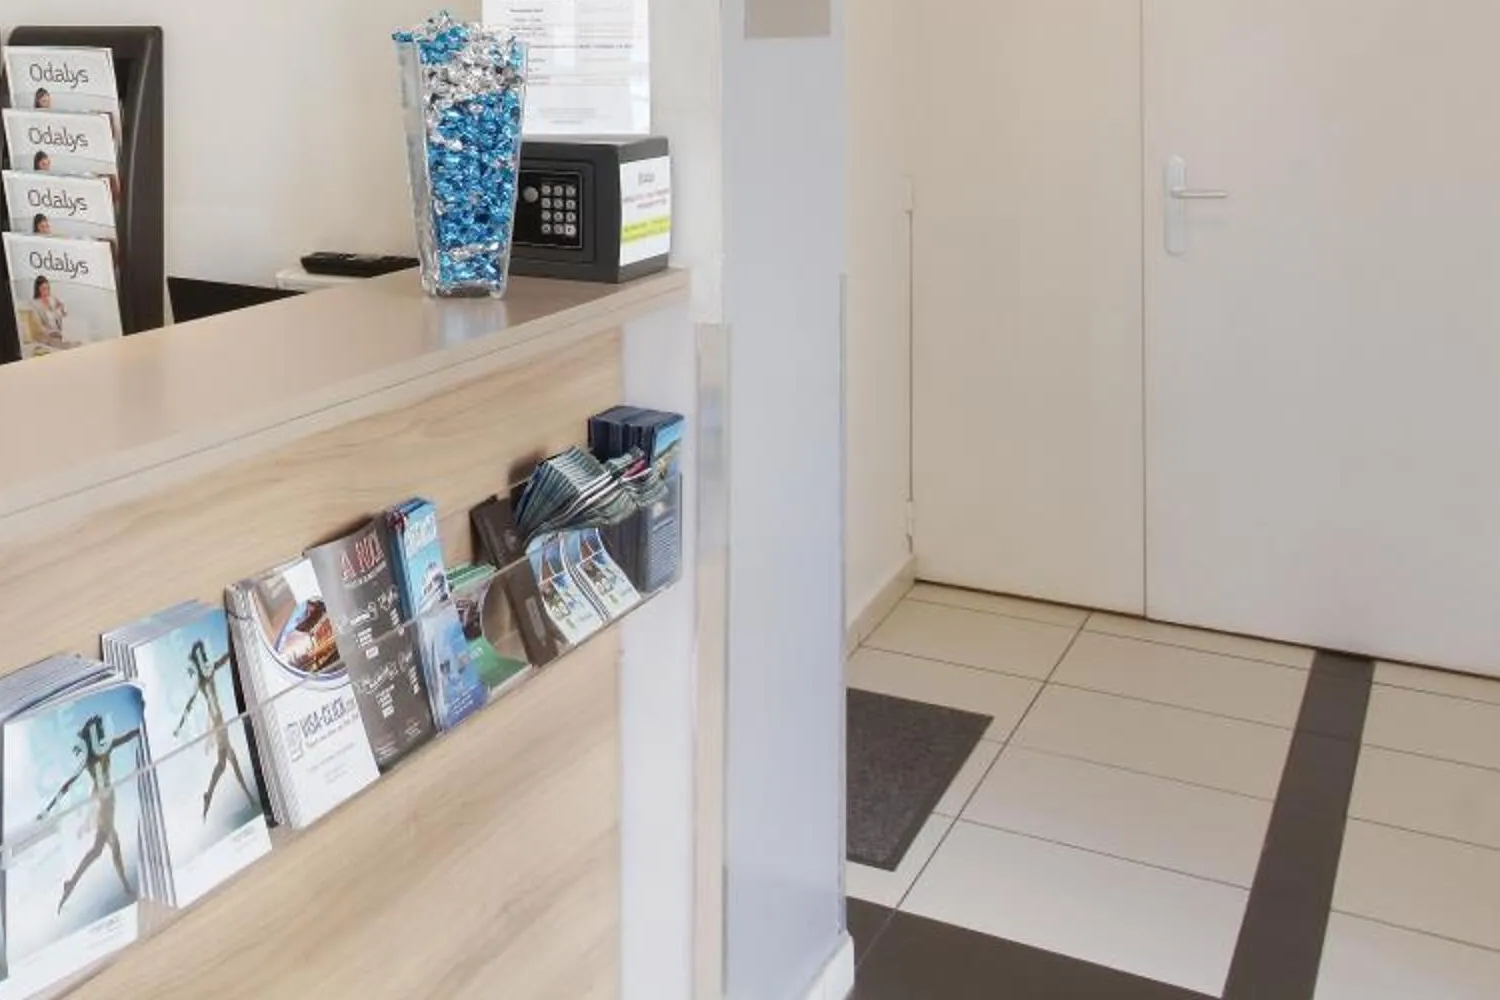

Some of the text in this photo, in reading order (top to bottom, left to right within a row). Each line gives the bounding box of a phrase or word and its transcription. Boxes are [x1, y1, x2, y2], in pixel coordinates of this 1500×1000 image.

[29, 63, 89, 92] Odalys
[28, 127, 88, 155] Odalys
[28, 189, 88, 219] Odalys
[29, 251, 89, 278] Odalys
